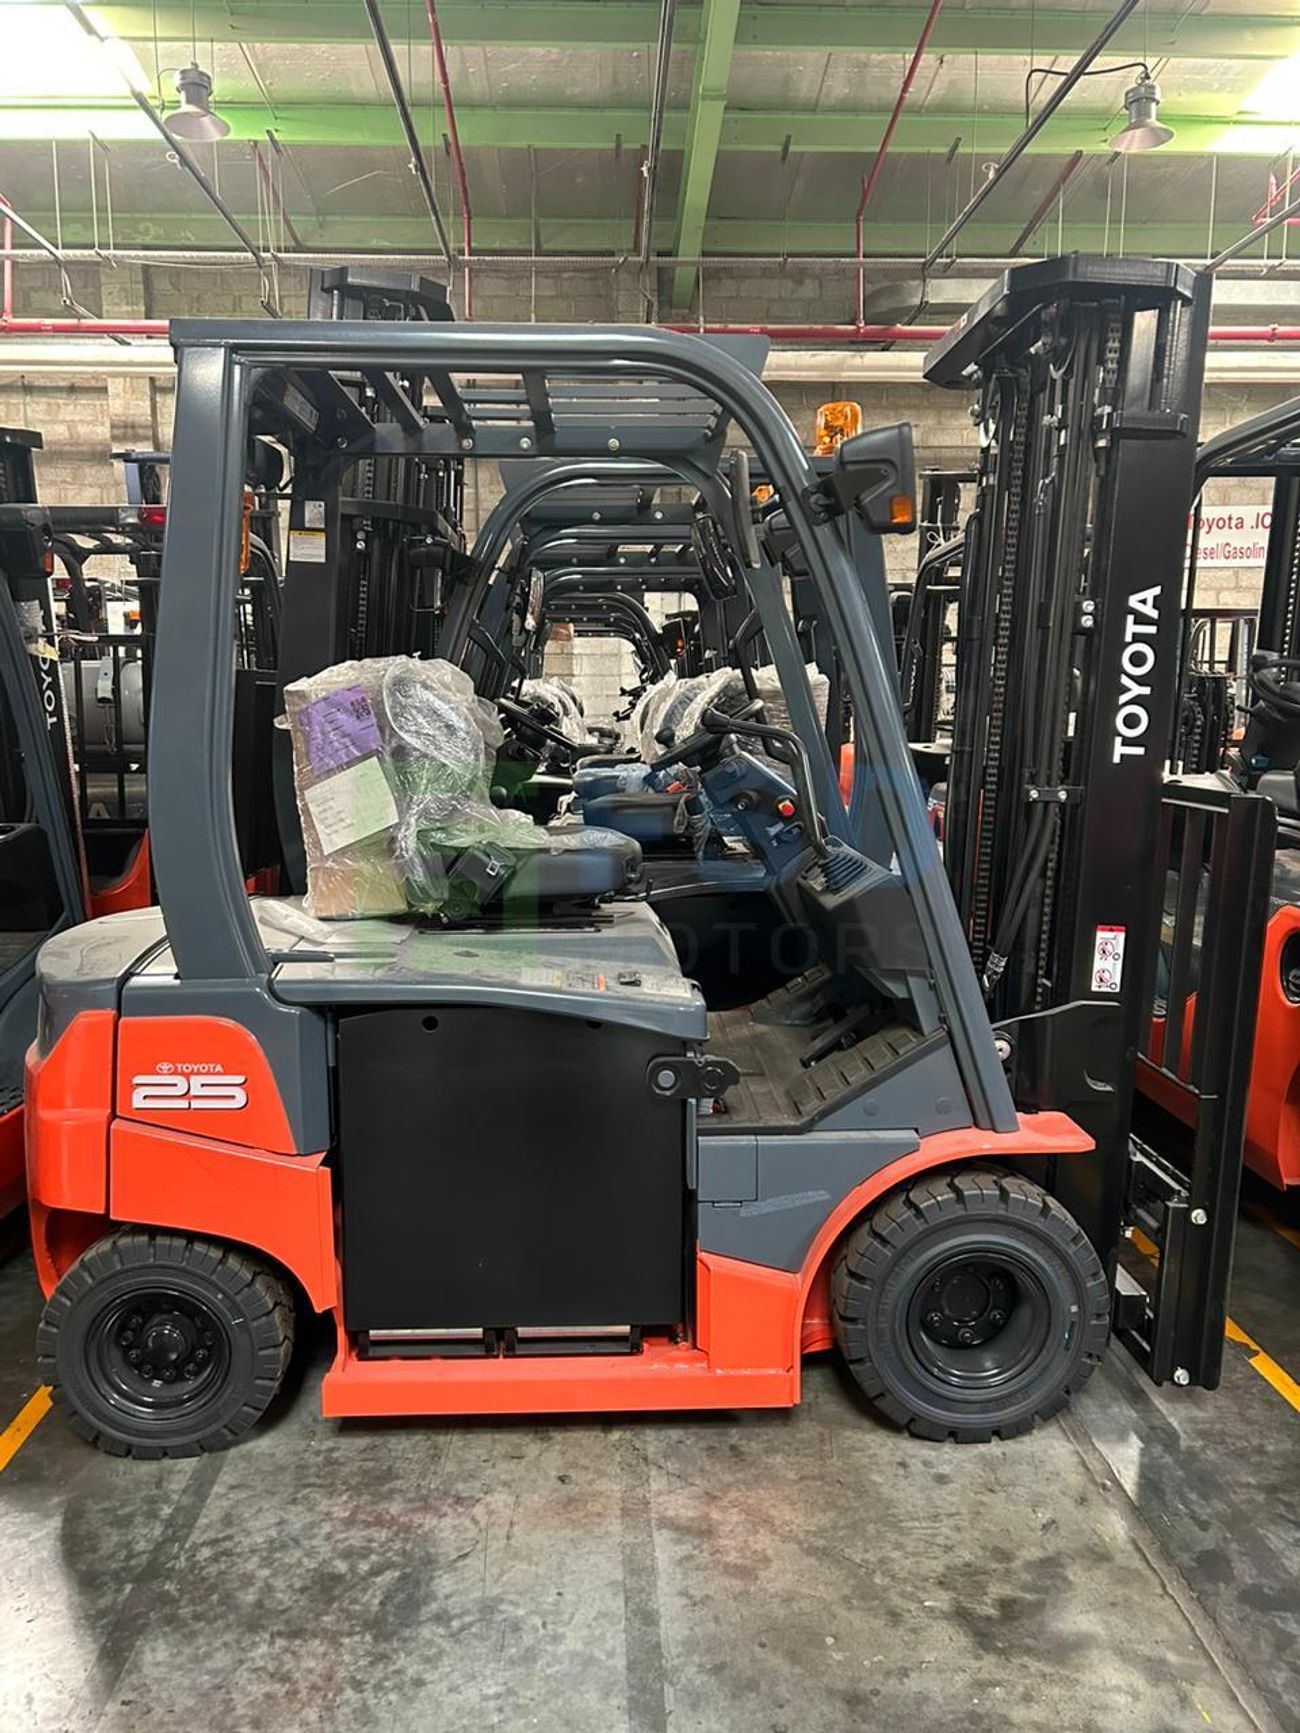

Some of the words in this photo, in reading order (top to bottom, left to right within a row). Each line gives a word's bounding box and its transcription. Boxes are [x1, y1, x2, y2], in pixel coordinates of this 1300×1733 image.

[1187, 542, 1265, 560] esel/Gasolin
[1112, 585, 1162, 764] TOYOTA
[39, 656, 58, 730] TOYO
[175, 1063, 224, 1074] TOYOTA
[132, 1075, 248, 1110] 25
